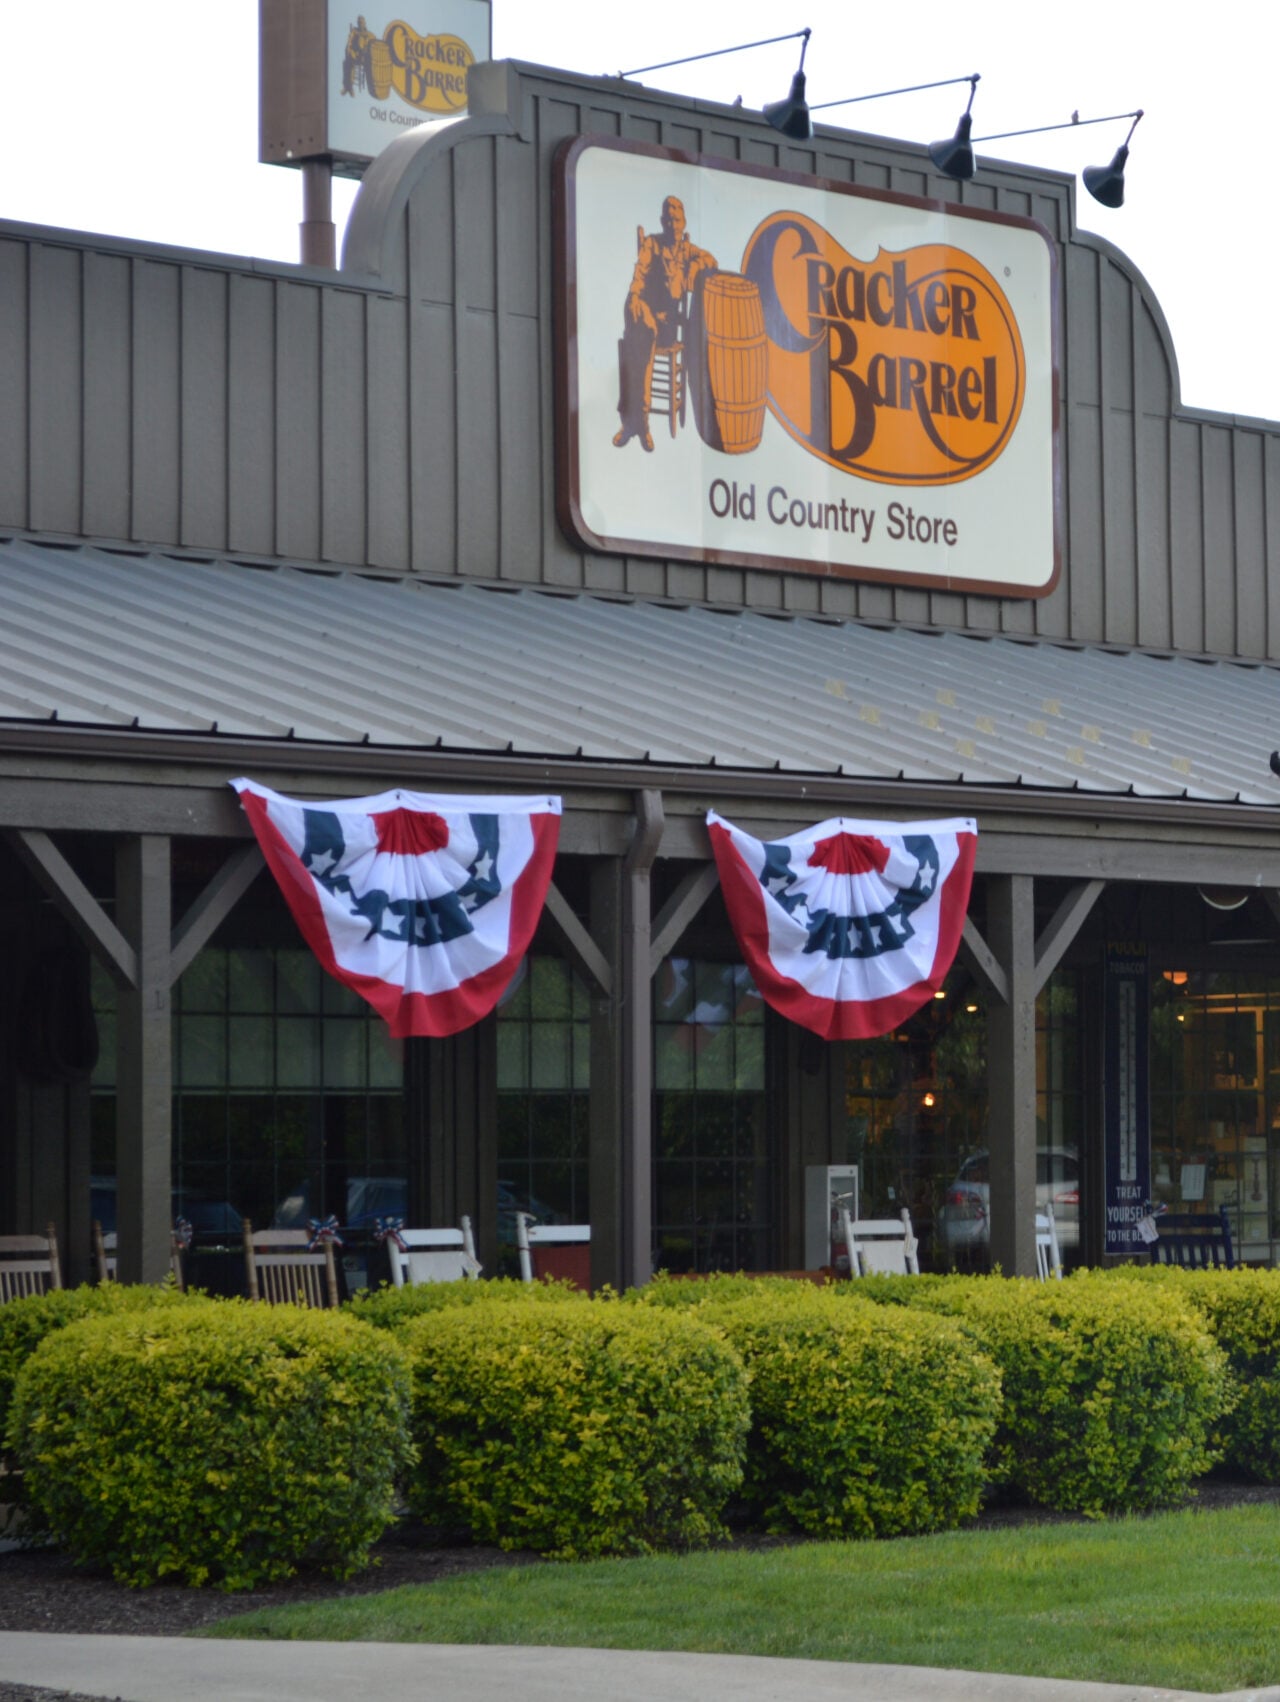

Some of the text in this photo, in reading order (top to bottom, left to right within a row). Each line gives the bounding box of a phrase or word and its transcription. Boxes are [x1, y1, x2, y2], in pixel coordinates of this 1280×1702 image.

[369, 106, 387, 121] Old
[709, 478, 958, 546] Old Country Store
[1116, 1186, 1142, 1199] TREAT
[1107, 1206, 1144, 1222] YOURSEL
[1107, 1230, 1117, 1242] TO
[1118, 1229, 1131, 1242] THE
